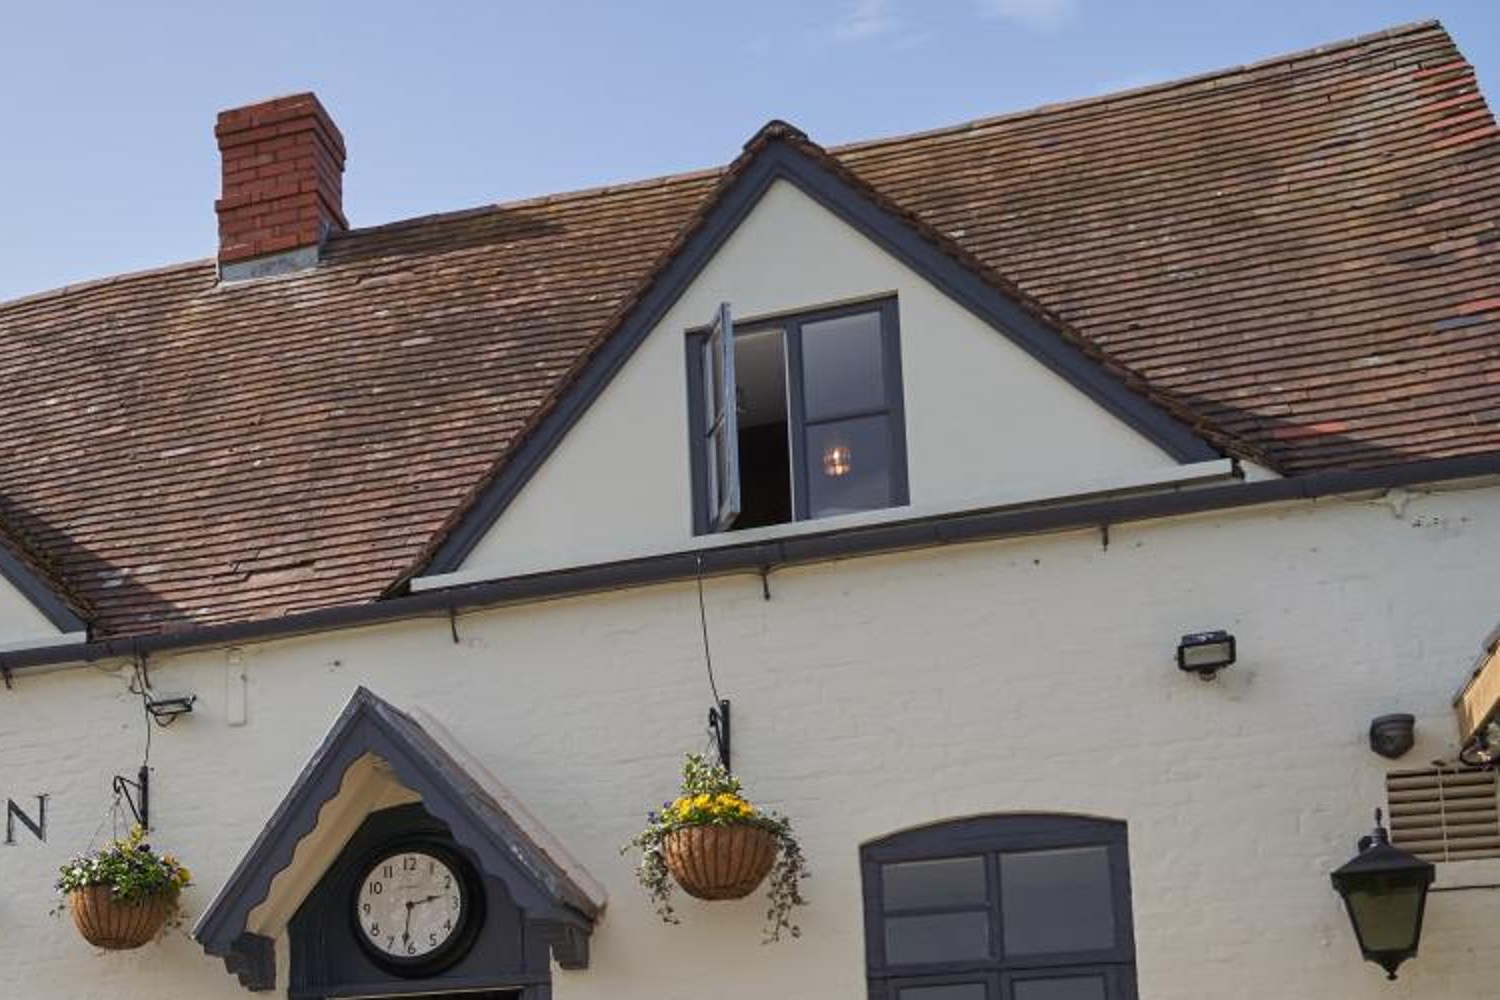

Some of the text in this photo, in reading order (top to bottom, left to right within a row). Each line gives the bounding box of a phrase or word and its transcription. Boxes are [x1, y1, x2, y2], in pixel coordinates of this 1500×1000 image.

[403, 857, 417, 871] 12
[383, 866, 393, 879] 11
[369, 882, 383, 895] 10
[444, 875, 452, 889] 2
[363, 903, 371, 915] 9
[452, 896, 459, 911] 3
[370, 923, 380, 937] 8
[443, 919, 452, 931] 4
[388, 936, 395, 951] 7
[429, 933, 437, 947] 5
[407, 941, 417, 955] 6
